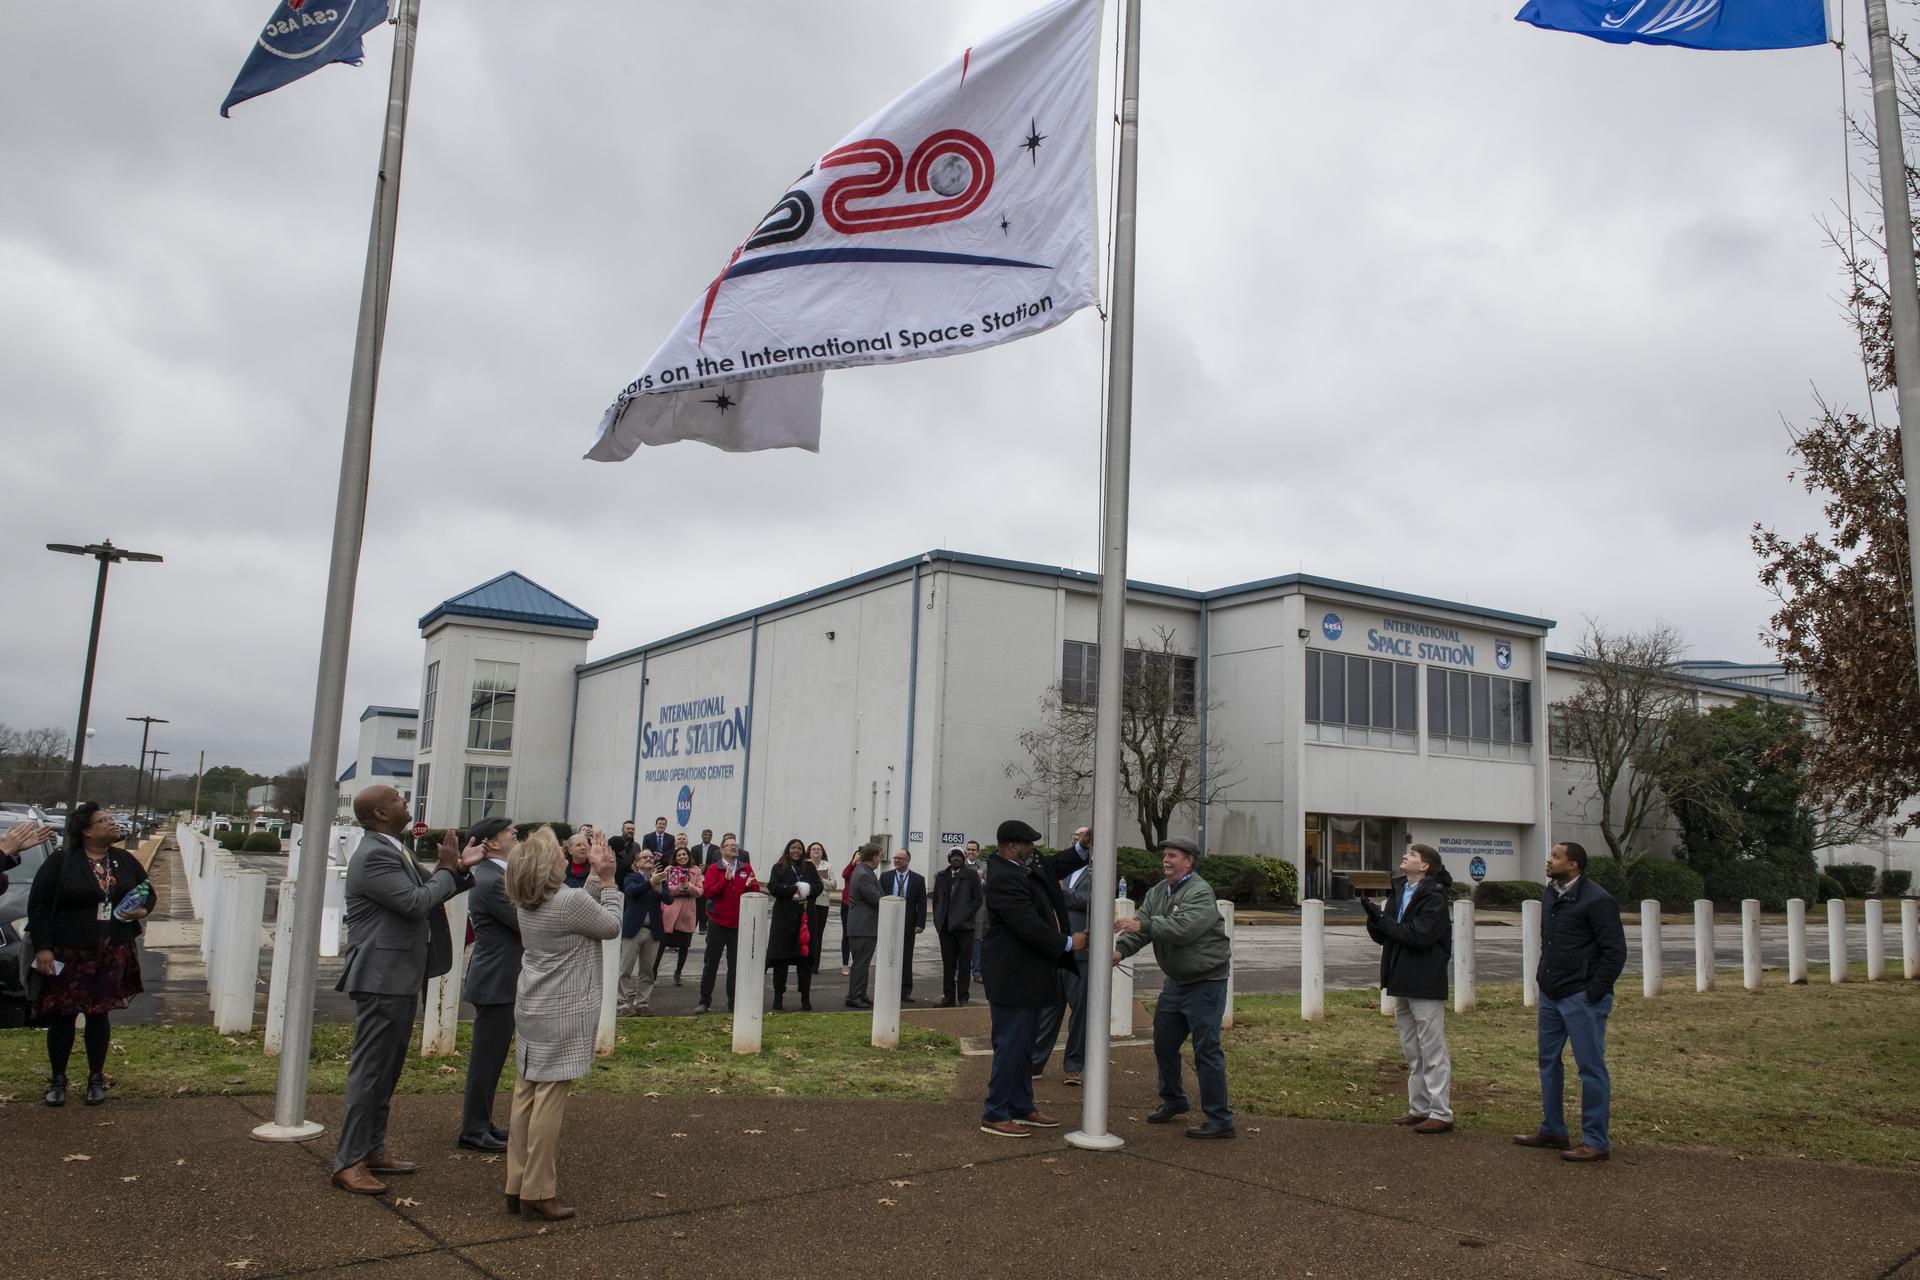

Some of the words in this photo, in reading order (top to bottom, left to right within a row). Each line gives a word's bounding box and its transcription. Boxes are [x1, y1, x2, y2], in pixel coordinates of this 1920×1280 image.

[660, 366, 690, 384] on
[696, 357, 735, 377] the
[741, 332, 893, 369] International
[898, 323, 975, 348] Space
[981, 295, 1054, 333] Station
[1383, 618, 1461, 643] INTERNATIONAL
[1367, 628, 1413, 656] SPACE
[1418, 643, 1474, 667] STATION
[660, 696, 725, 724] INTERNATIONAL
[641, 721, 679, 759] SPACE
[685, 705, 749, 756] STATION
[645, 769, 669, 782] PAYLOAD
[669, 766, 707, 781] OPERATIONS
[707, 765, 734, 780] CENTER
[911, 833, 923, 842] 4663
[942, 834, 964, 843] 4663
[1439, 846, 1471, 854] ENGINEERING
[1472, 847, 1494, 855] SUPPORT
